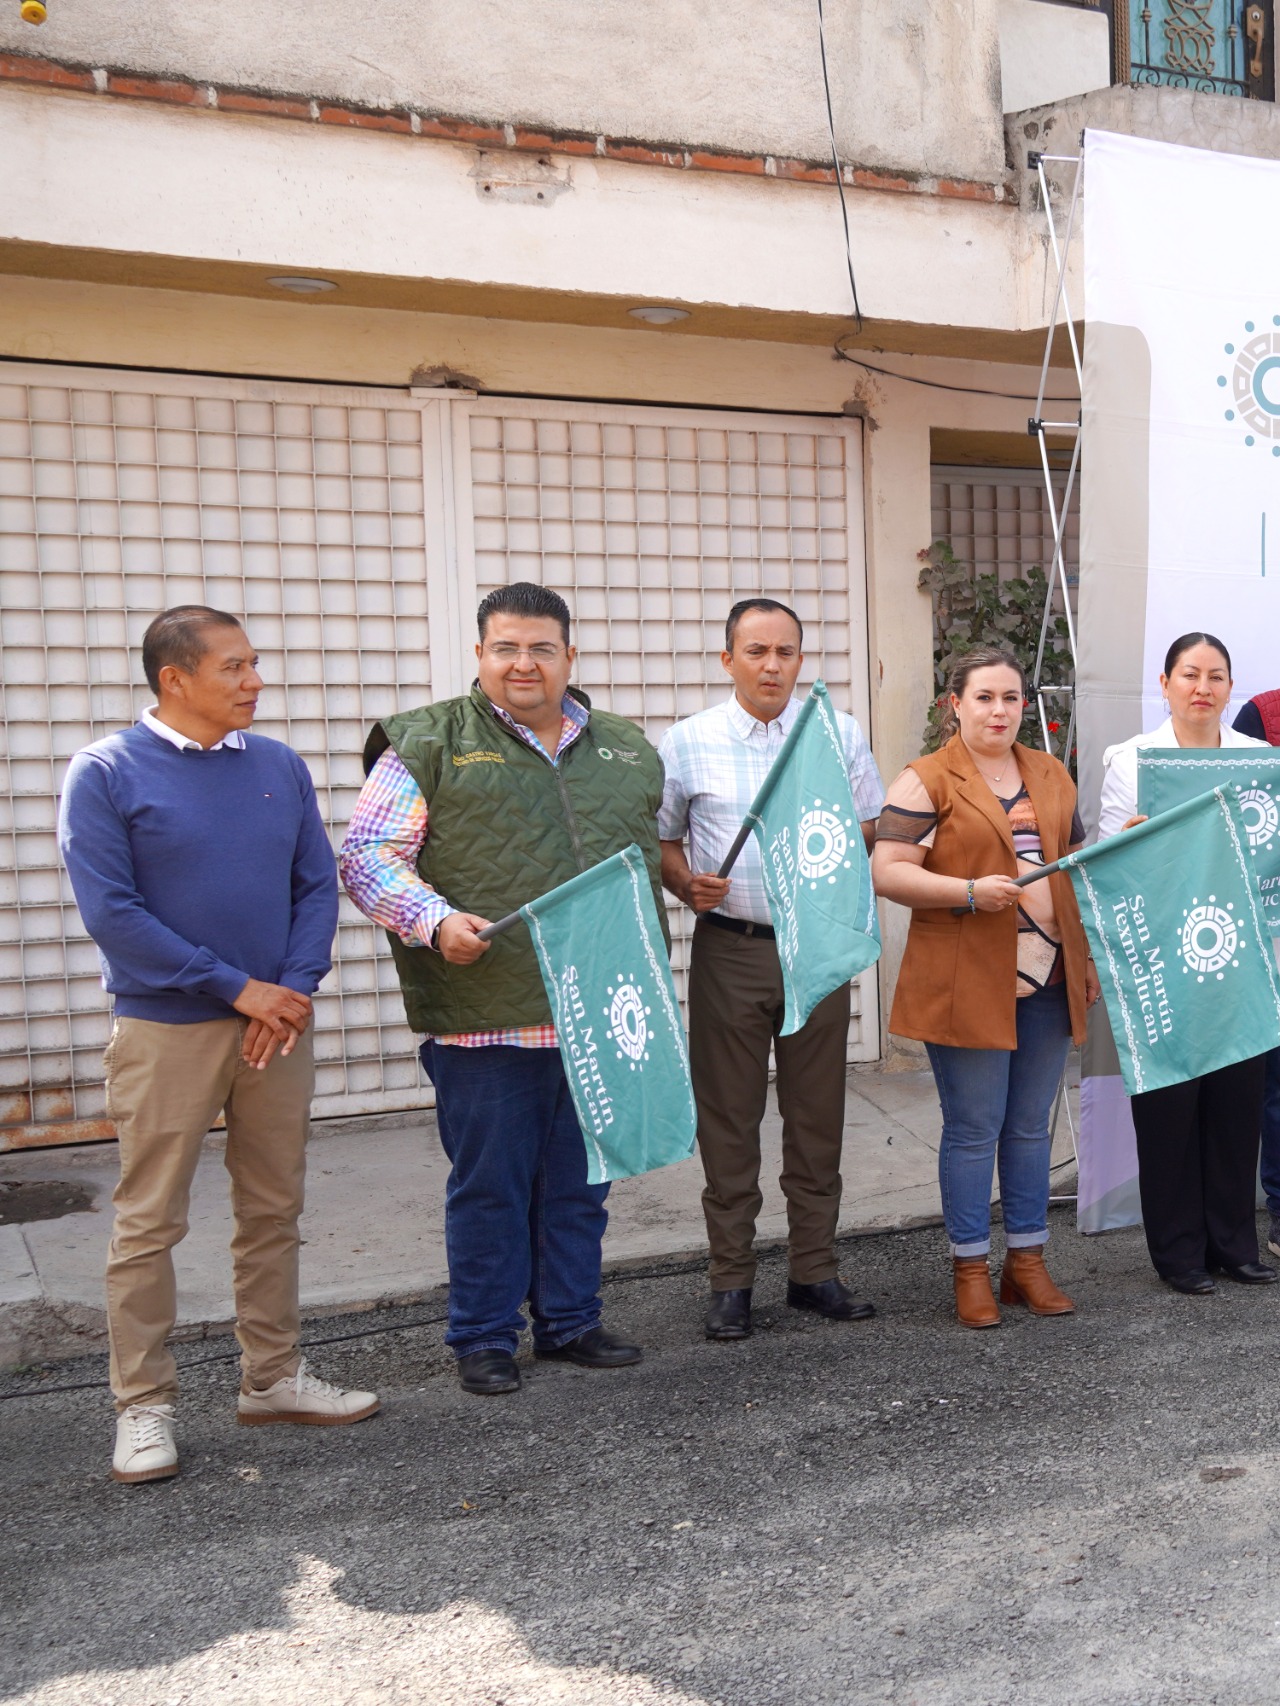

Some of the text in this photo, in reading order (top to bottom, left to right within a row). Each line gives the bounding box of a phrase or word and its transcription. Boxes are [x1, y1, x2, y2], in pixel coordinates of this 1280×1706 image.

[778, 826, 796, 874] San
[1112, 896, 1160, 1046] Texmelucan
[1128, 894, 1174, 1036] San Martín
[567, 965, 615, 1127] San Martín
